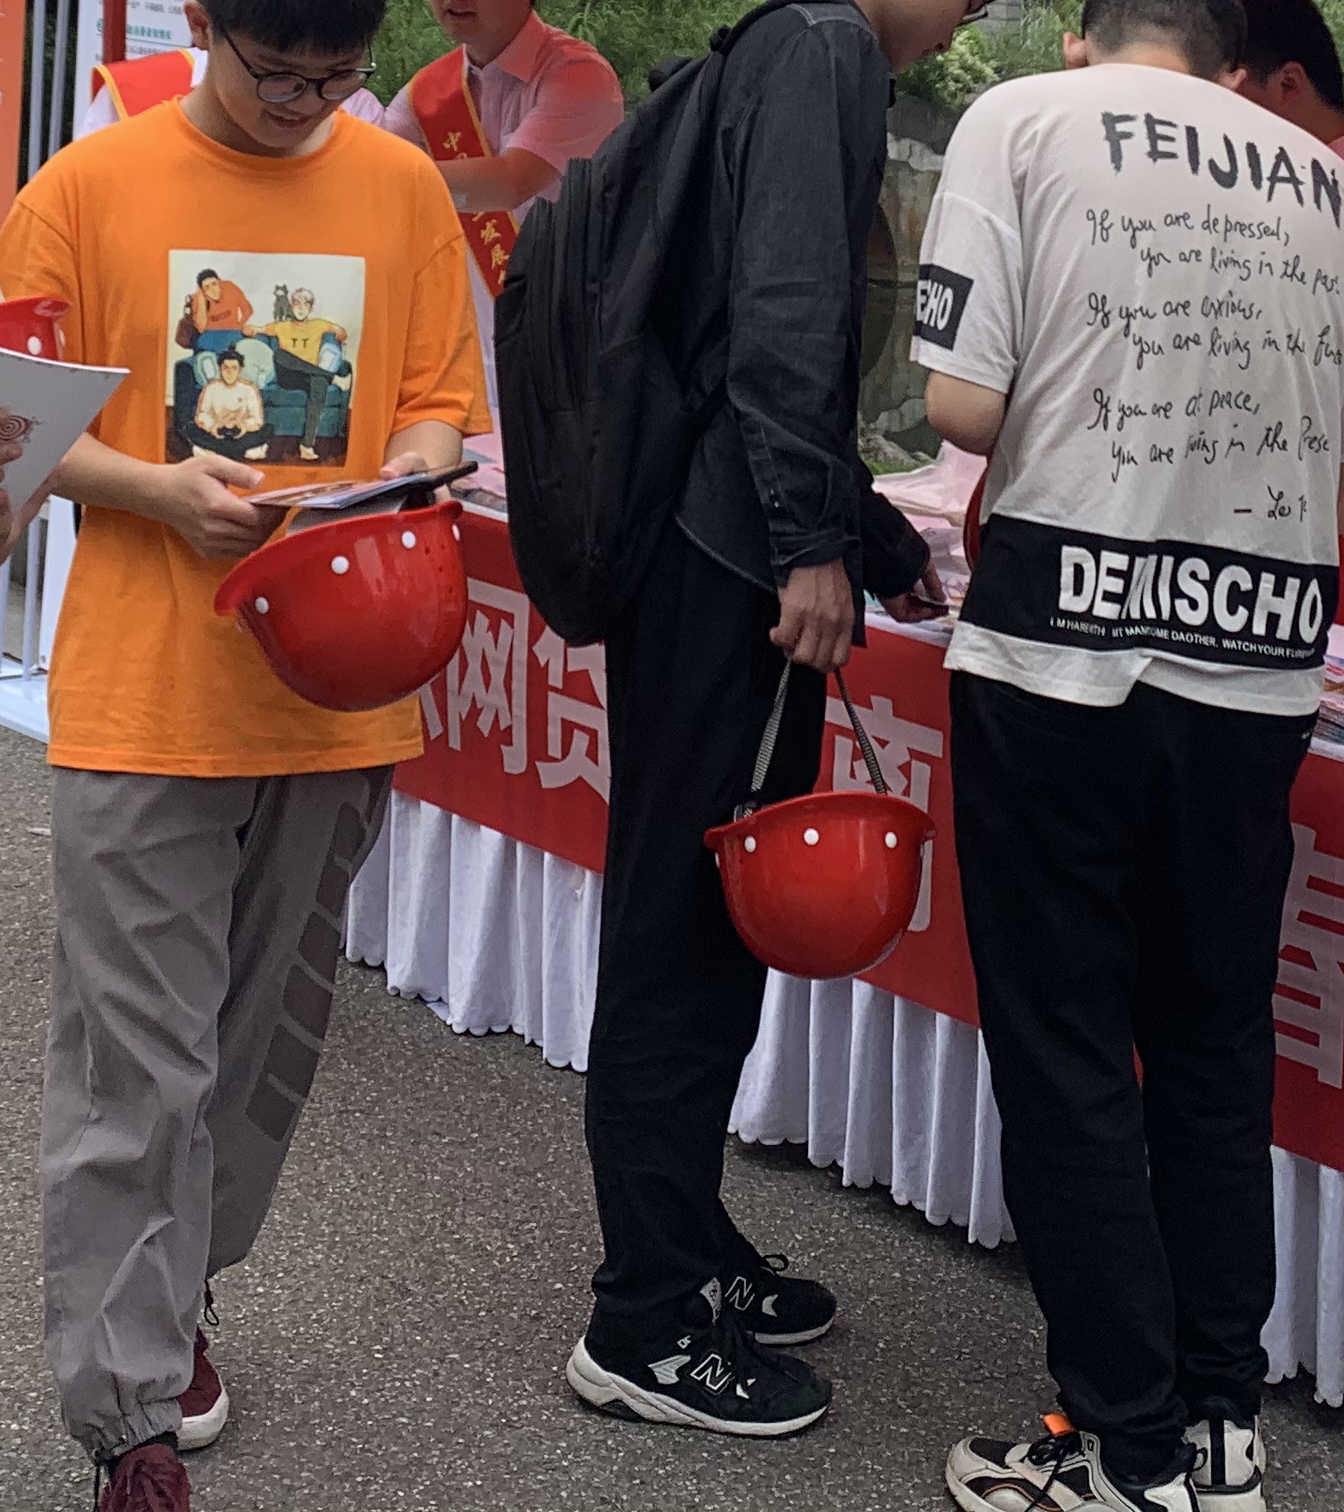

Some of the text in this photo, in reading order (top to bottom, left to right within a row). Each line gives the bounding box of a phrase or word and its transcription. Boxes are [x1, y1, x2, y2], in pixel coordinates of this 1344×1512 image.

[1101, 111, 1343, 229] FEIJIAN
[1086, 209, 1114, 245] If
[1121, 215, 1156, 249] you
[1164, 211, 1194, 230] are
[1178, 247, 1203, 263] are
[1210, 246, 1252, 281] living
[1280, 253, 1307, 285] the
[1087, 292, 1111, 329] If
[1118, 303, 1157, 337] you
[1163, 299, 1191, 317] are
[1133, 332, 1165, 371] you
[1173, 333, 1202, 351] are
[1208, 326, 1251, 370] living
[1263, 330, 1281, 353] in
[1117, 398, 1148, 432] you
[1149, 444, 1174, 465] are
[1256, 420, 1288, 457] the
[419, 576, 612, 806] 网贷
